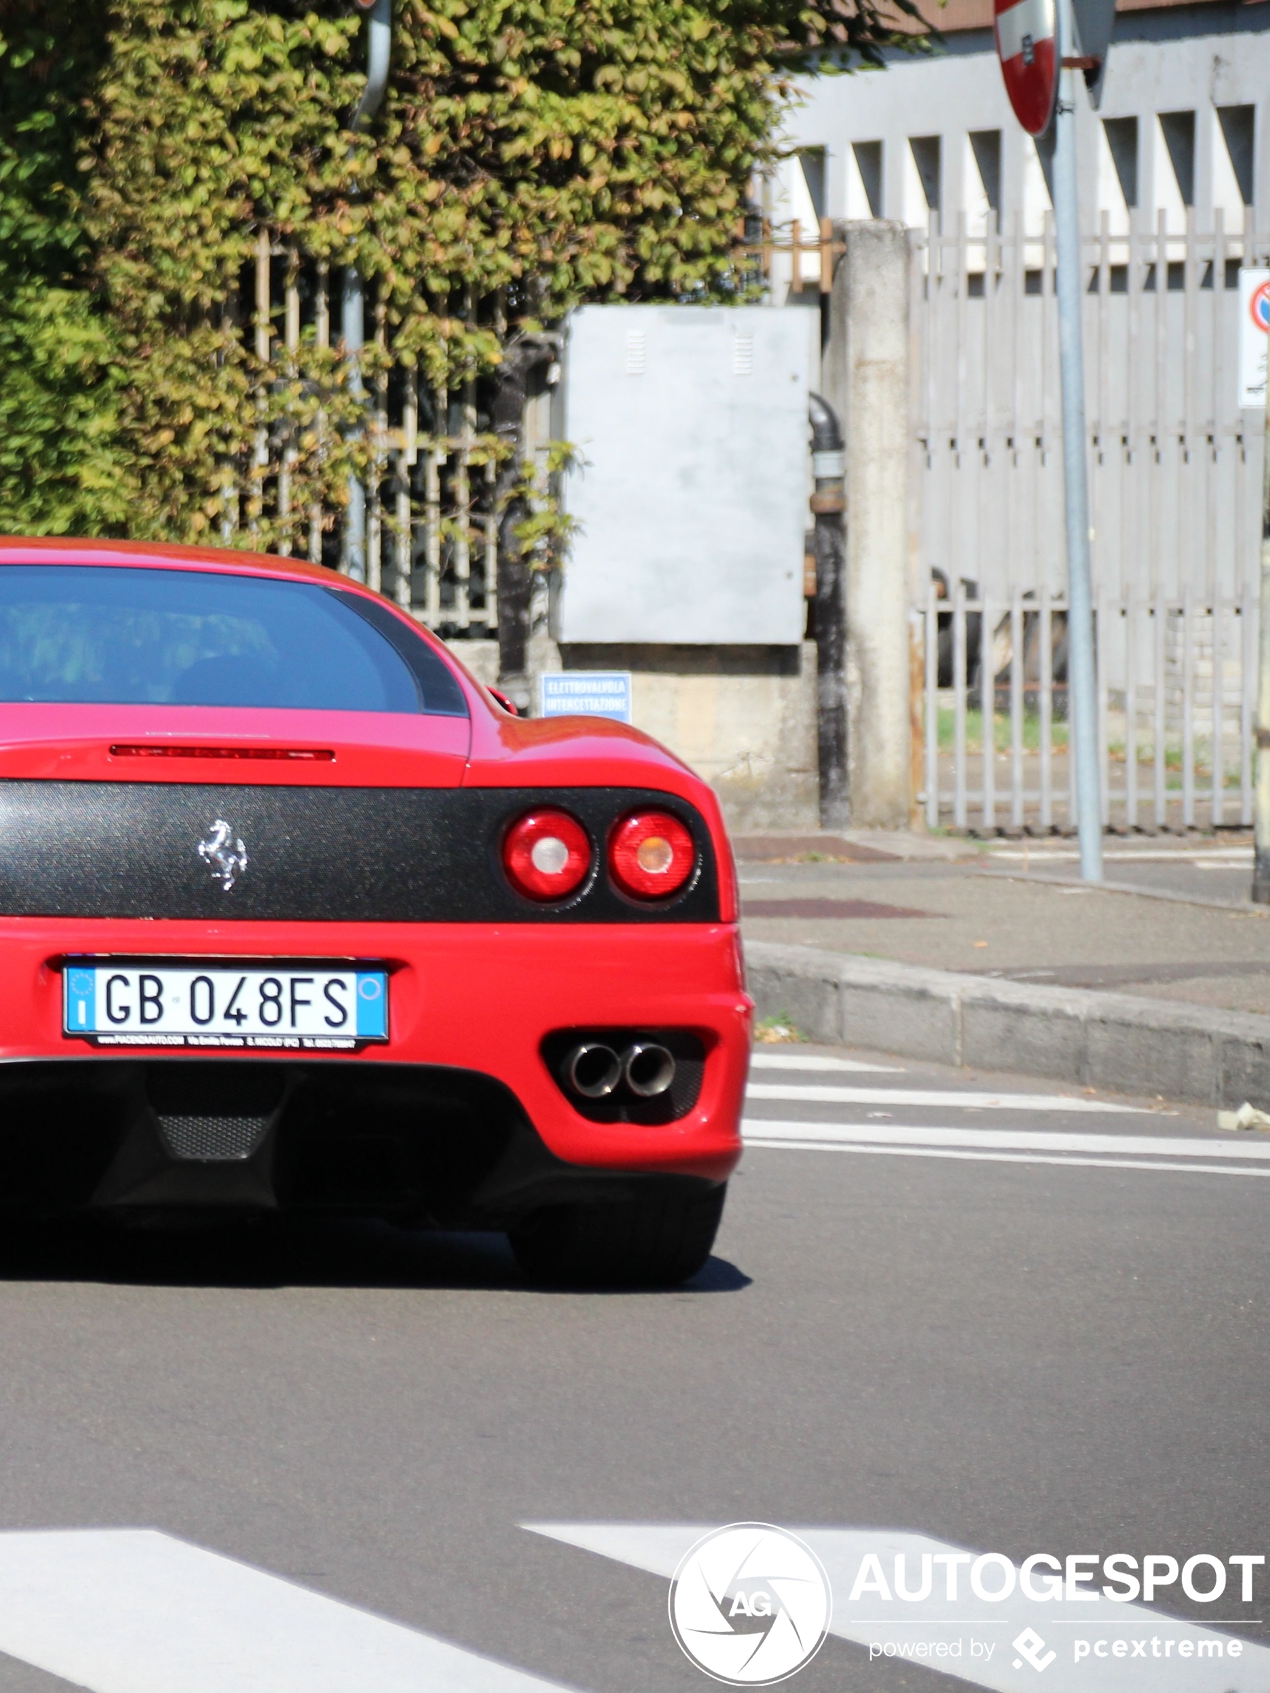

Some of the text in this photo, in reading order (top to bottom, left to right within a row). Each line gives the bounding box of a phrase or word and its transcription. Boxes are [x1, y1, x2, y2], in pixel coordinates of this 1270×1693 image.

[549, 681, 626, 694] ELETTROVALVOLA
[546, 698, 627, 712] INTERCETTAZIONE
[106, 974, 348, 1027] GB 048FS
